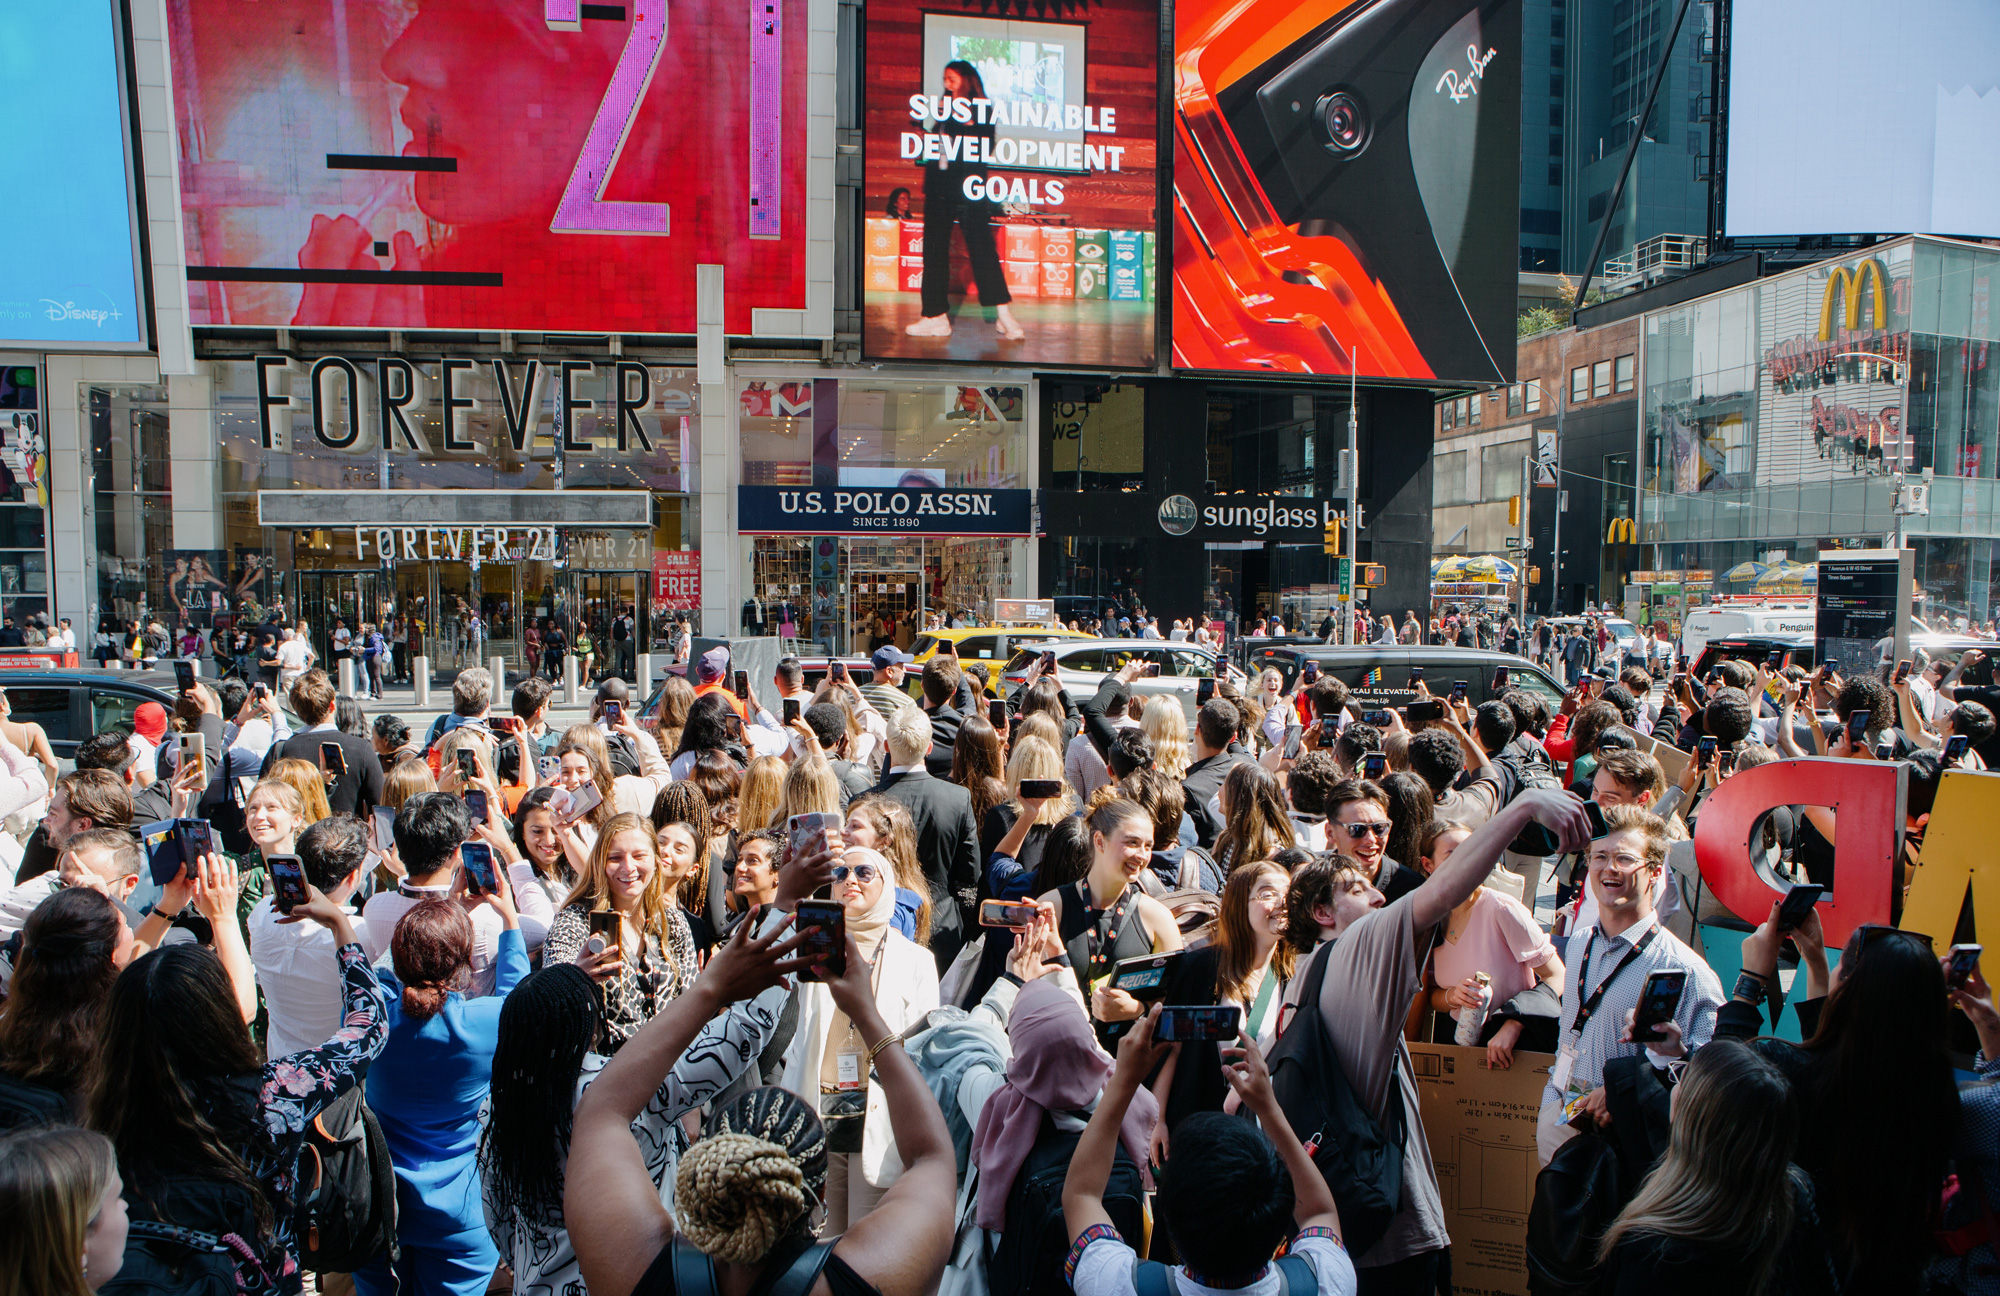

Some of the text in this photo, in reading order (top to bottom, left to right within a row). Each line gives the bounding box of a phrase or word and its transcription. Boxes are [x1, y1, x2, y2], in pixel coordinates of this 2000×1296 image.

[909, 94, 1117, 133] SUSTAINABLE
[900, 132, 1125, 171] DEVELOPMENT
[963, 174, 1064, 205] GOALS
[0, 310, 15, 320] nly
[254, 355, 658, 456] FOREVER
[779, 492, 996, 516] U.S. POLO ASSN.
[852, 518, 920, 527] SINCE 1890
[1204, 500, 1317, 534] sunglass
[355, 527, 510, 560] FOREVER
[527, 527, 556, 560] 21
[569, 538, 616, 558] EVER
[628, 538, 646, 558] 21
[667, 555, 689, 565] SALE
[659, 577, 699, 595] FREE
[186, 590, 206, 608] LA
[1780, 624, 1814, 632] Penguin
